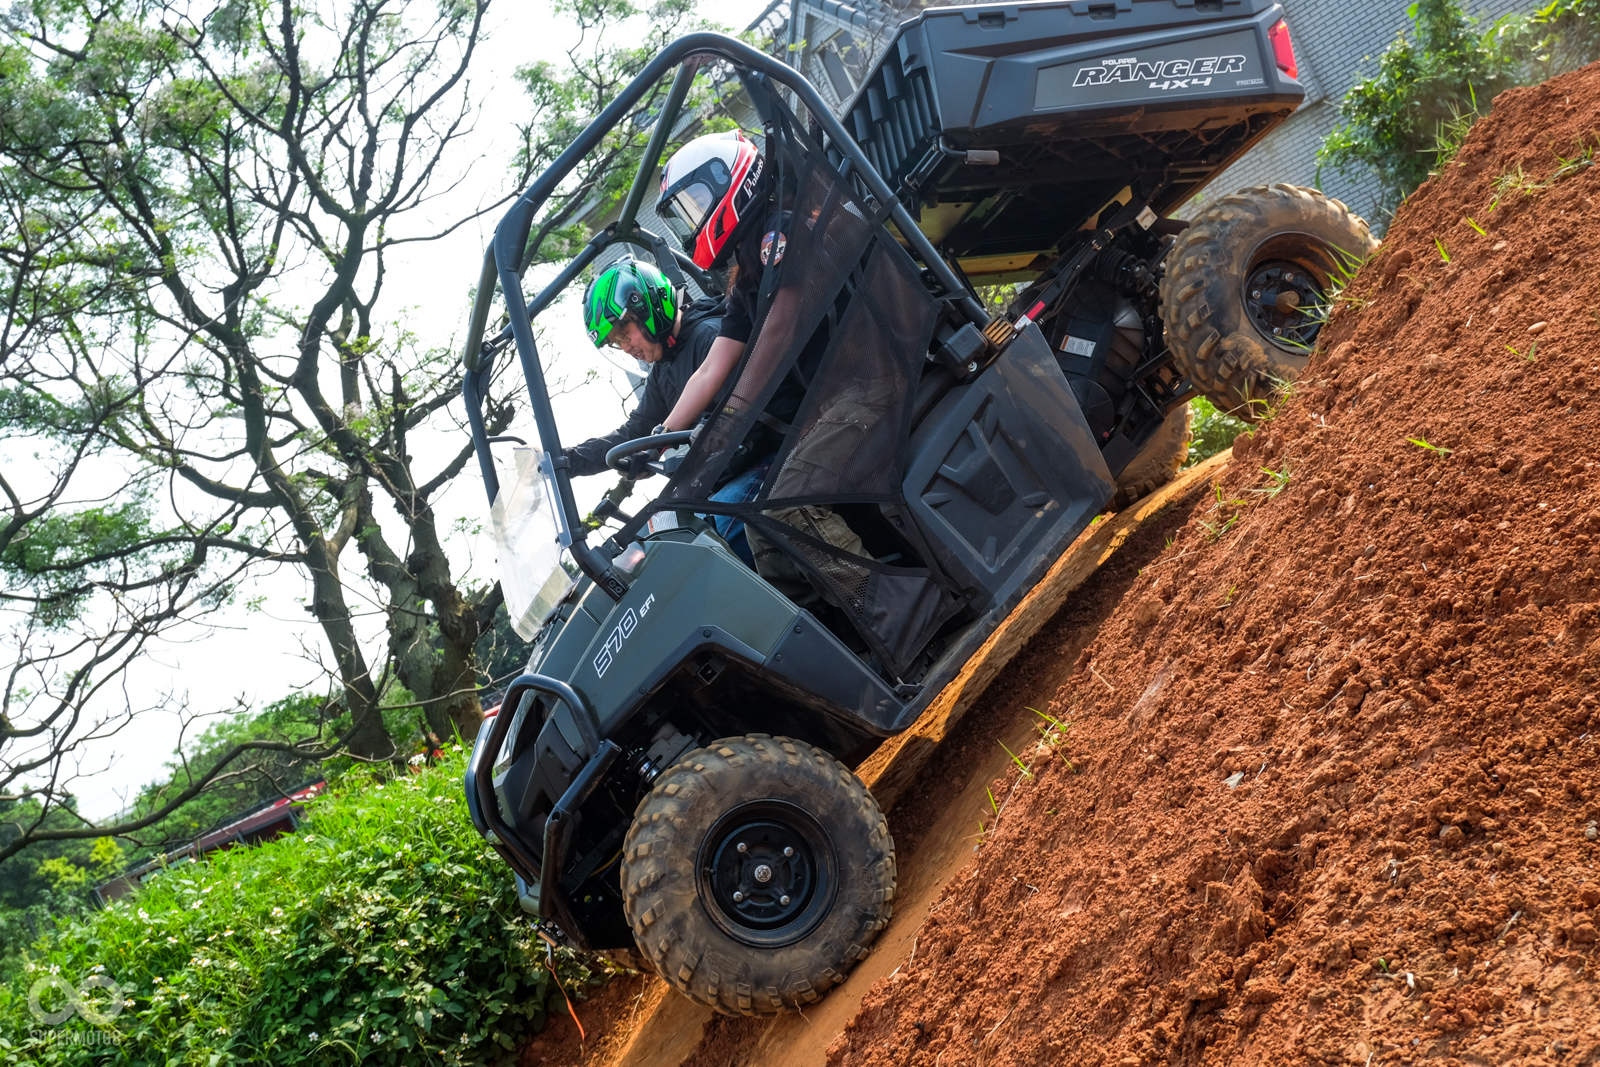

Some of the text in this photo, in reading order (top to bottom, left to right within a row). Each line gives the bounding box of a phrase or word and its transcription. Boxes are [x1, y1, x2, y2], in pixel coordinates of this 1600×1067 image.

[1072, 55, 1246, 87] RANGER
[1102, 57, 1137, 66] POLARIS
[743, 158, 764, 199] Polaris
[593, 593, 655, 678] 570 EFI
